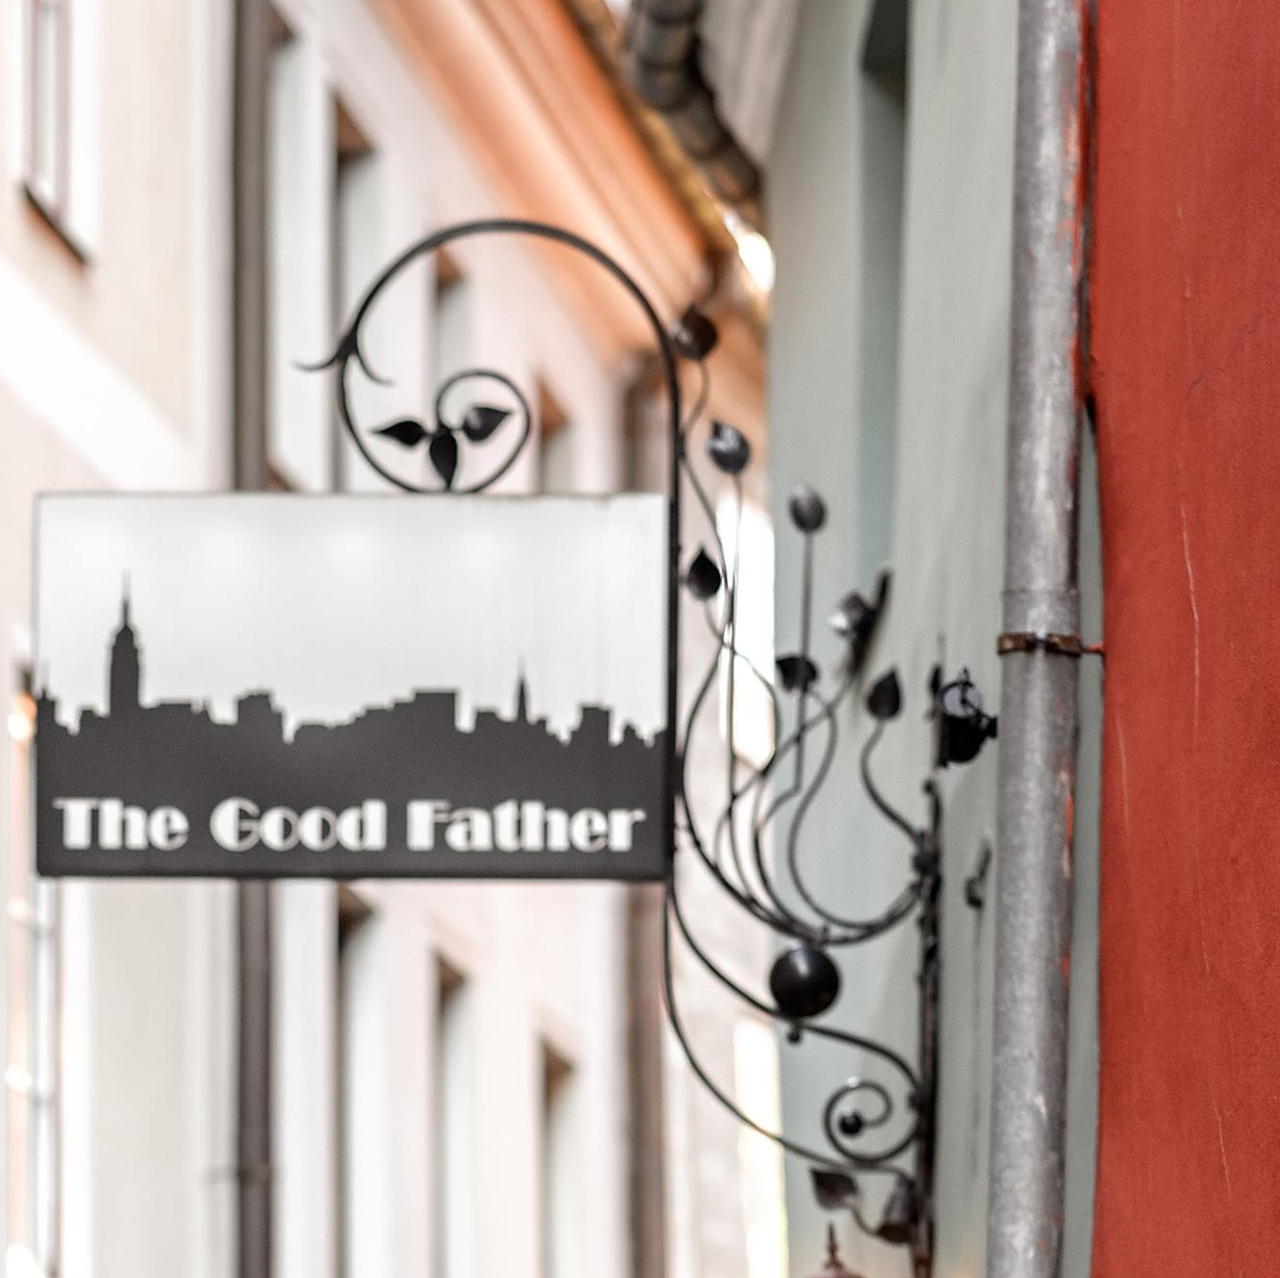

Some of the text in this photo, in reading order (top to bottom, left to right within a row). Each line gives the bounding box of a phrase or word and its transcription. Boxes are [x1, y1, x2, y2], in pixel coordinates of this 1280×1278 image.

[53, 797, 645, 852] The Good Father
